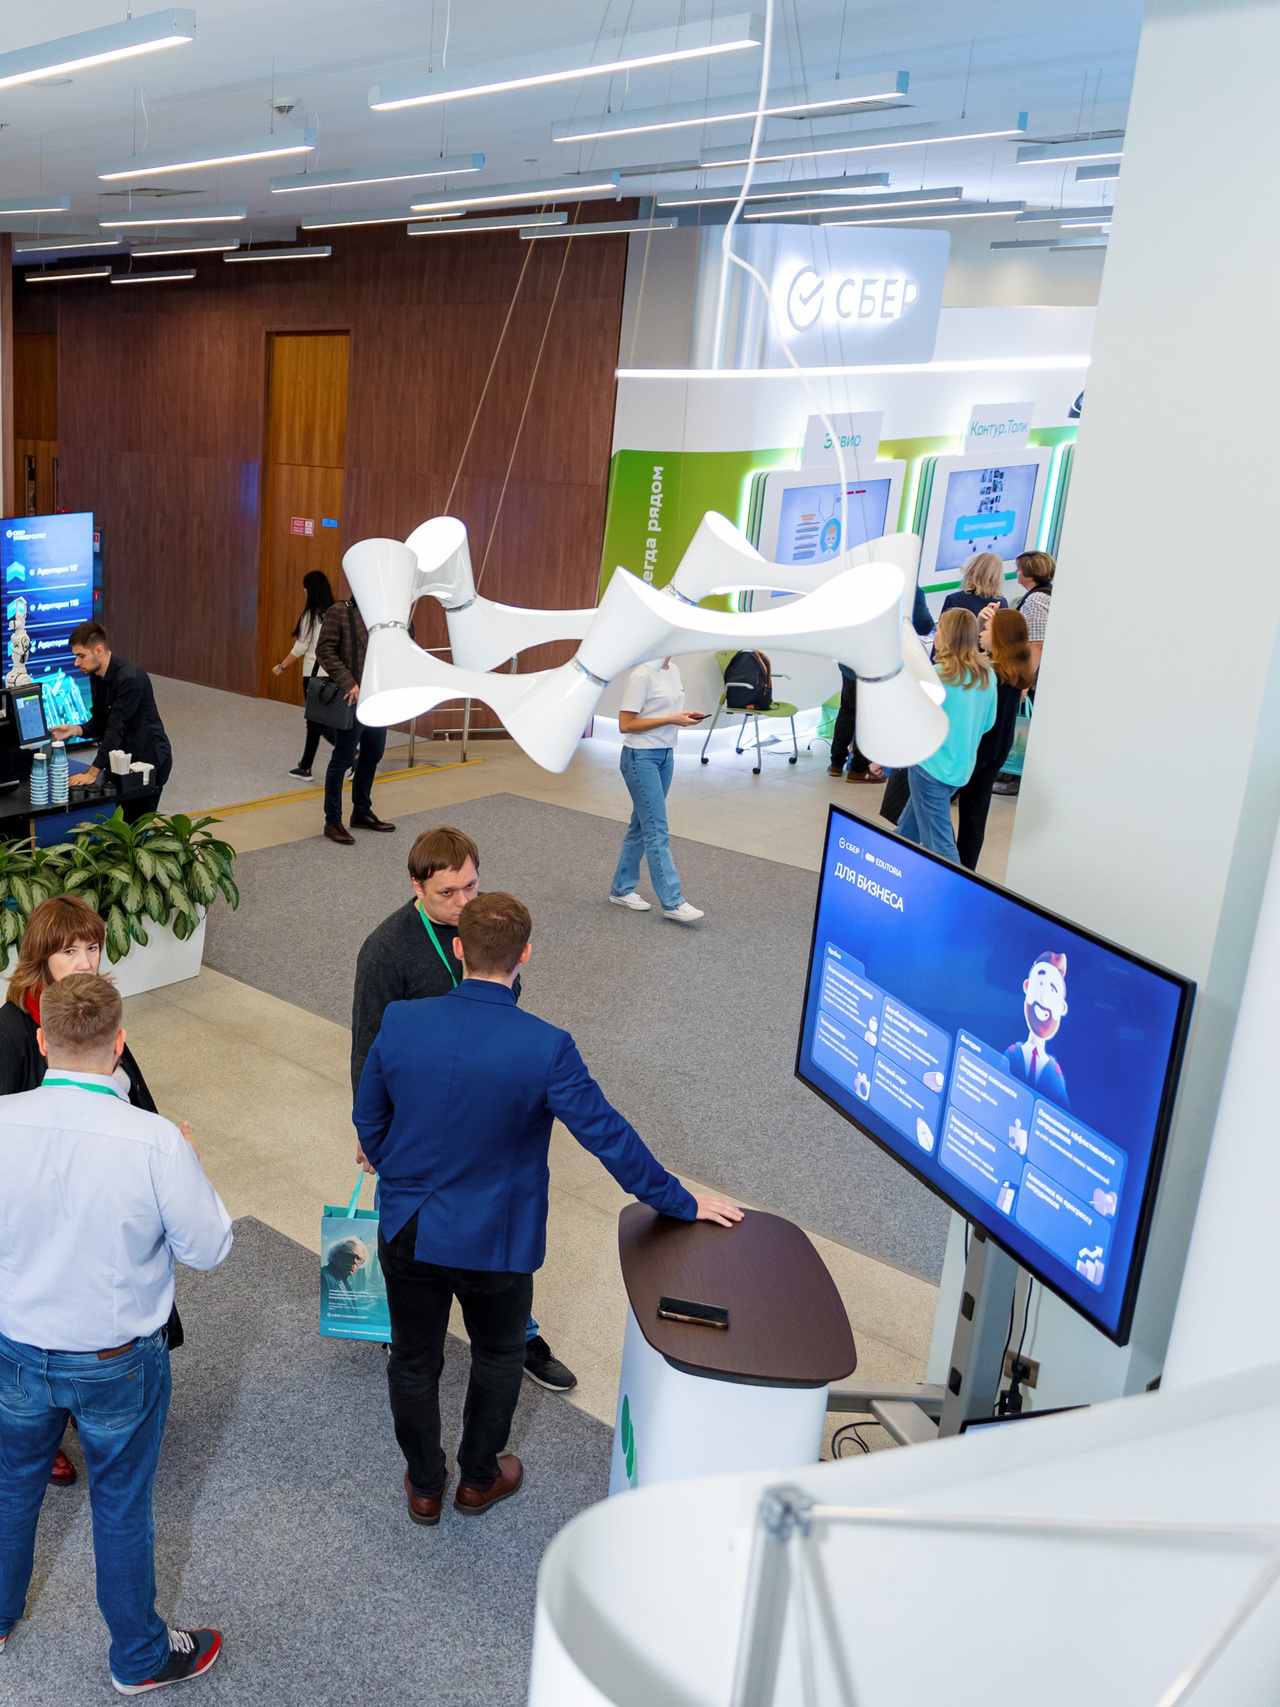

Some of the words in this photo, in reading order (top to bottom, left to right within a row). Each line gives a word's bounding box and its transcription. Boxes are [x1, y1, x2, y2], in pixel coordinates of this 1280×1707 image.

[836, 278, 920, 319] СБЕР
[970, 419, 1028, 438] Контур.Толк
[823, 432, 862, 449] Эвио
[647, 465, 664, 532] рядом
[642, 537, 659, 585] егда
[37, 566, 69, 576] Аудитория
[37, 602, 70, 612] Аудитория
[846, 842, 860, 854] СБЕР
[875, 858, 902, 878] EDUTORIA
[834, 862, 857, 884] ДЛЯ
[856, 874, 904, 912] БИЗНЕСА
